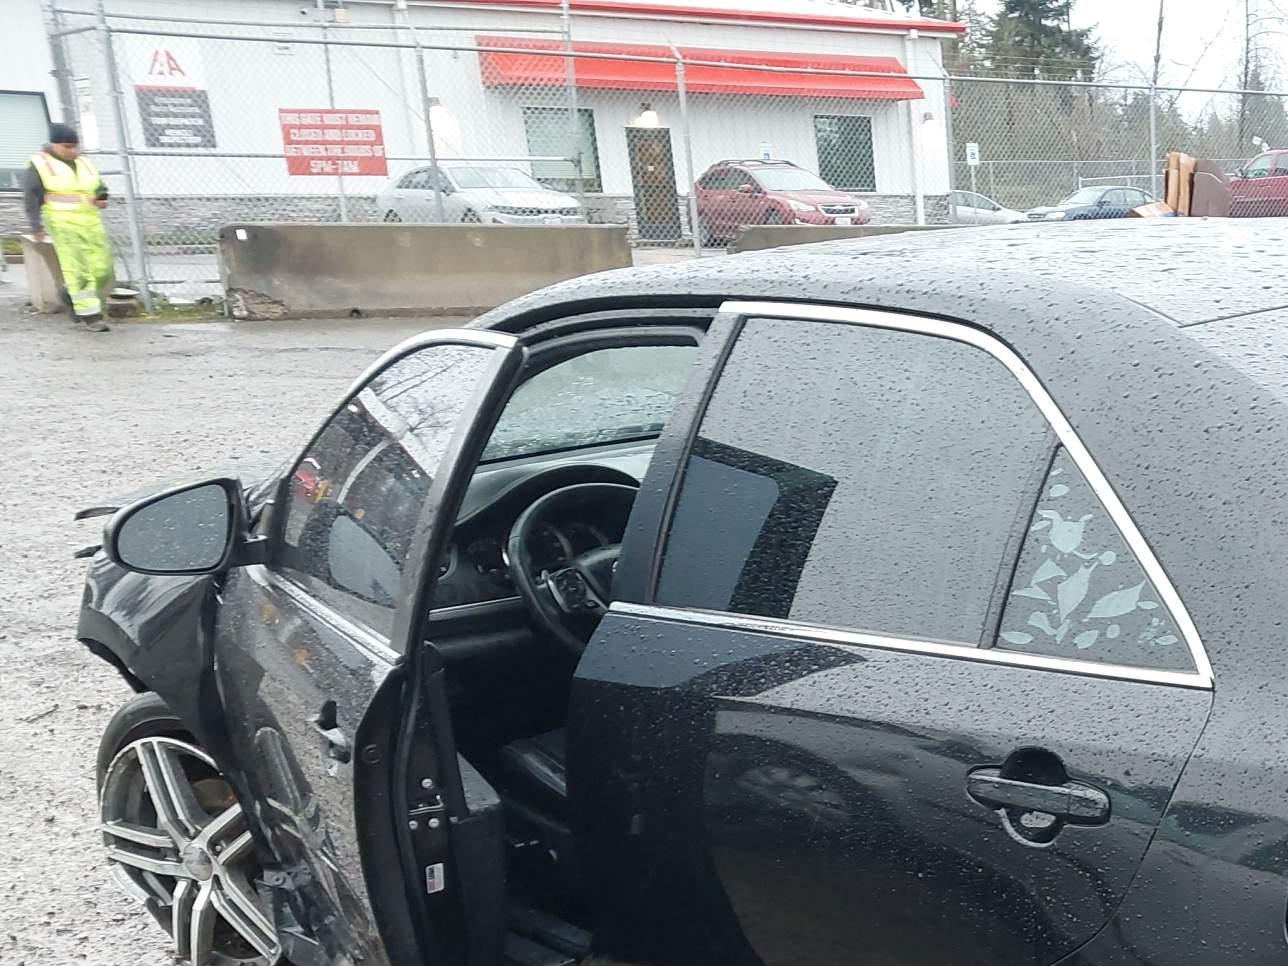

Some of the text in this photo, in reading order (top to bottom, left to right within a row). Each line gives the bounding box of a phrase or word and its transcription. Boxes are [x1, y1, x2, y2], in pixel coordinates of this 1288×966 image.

[289, 128, 322, 141] CLOSED
[342, 129, 376, 141] LOCKED
[310, 159, 360, 173] 5PM-7AM
